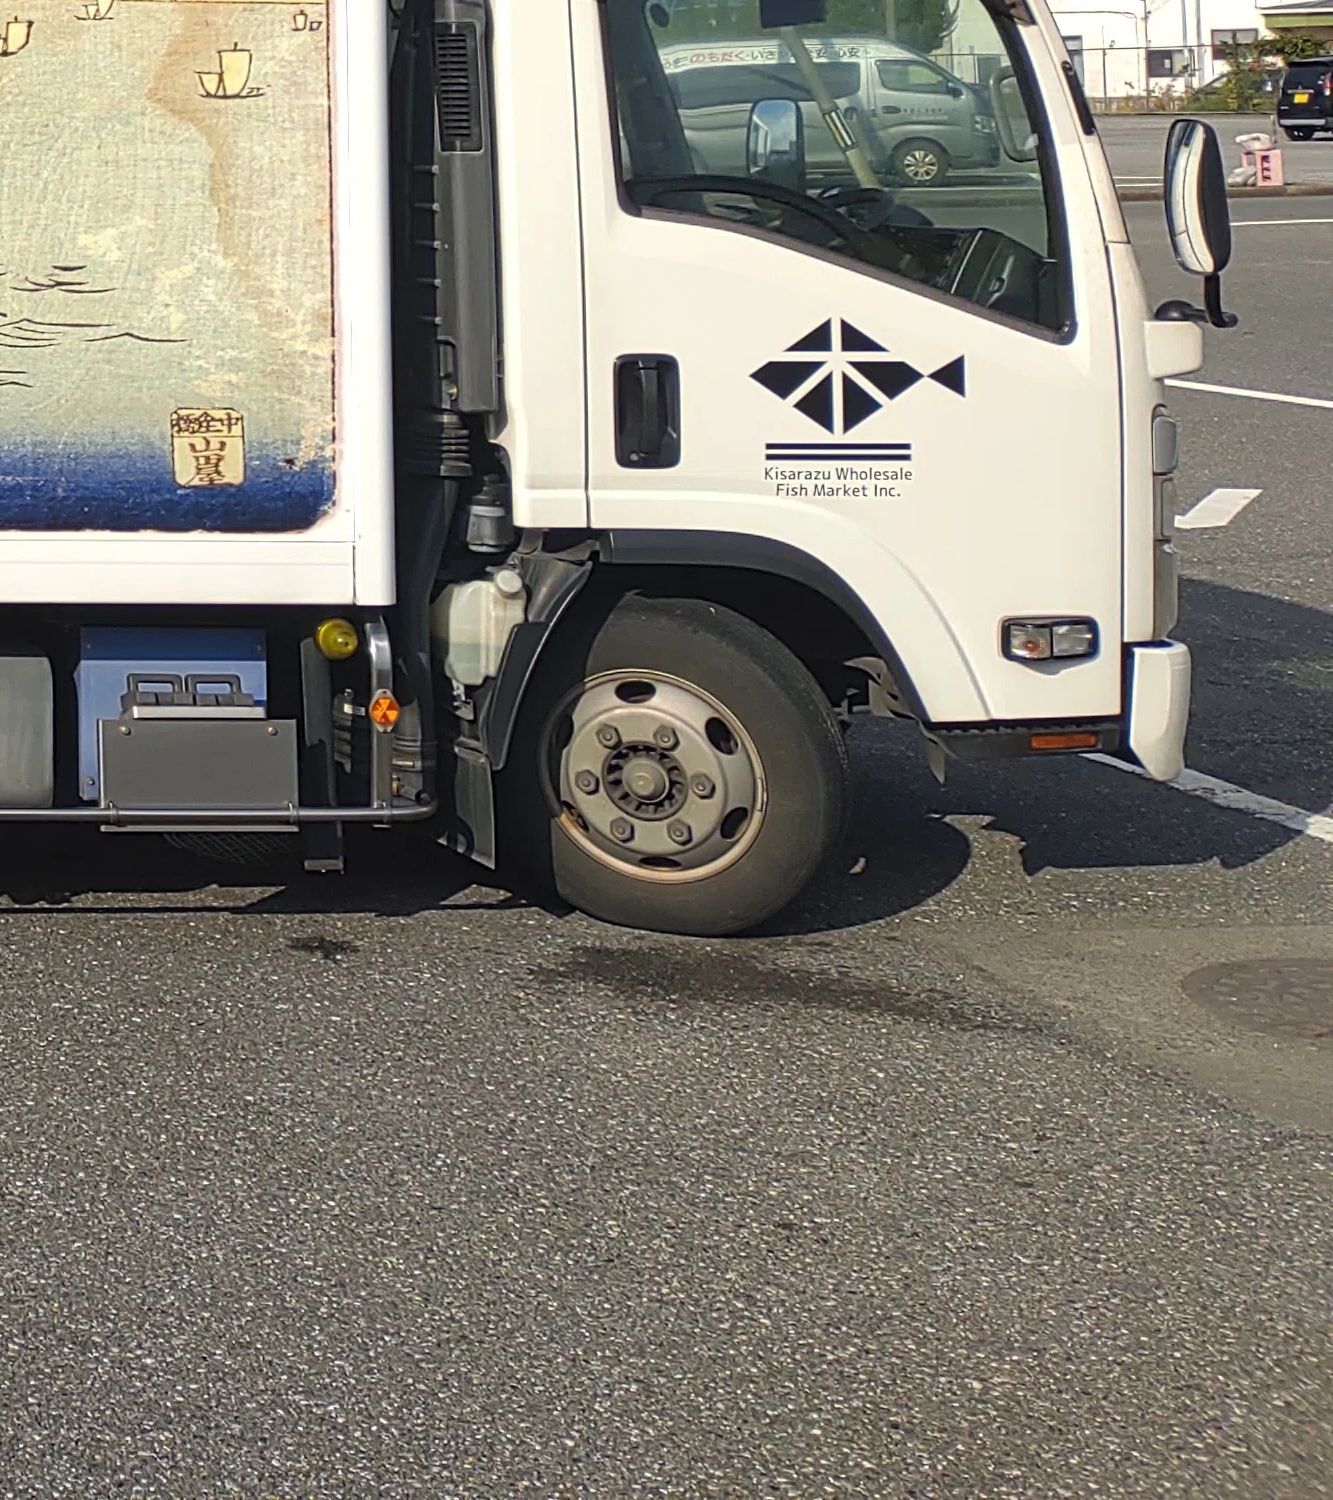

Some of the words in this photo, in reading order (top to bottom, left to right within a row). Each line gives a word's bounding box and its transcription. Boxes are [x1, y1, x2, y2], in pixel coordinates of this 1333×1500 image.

[764, 467, 831, 481] Kisarazu
[835, 467, 913, 481] Wholesale
[776, 484, 808, 497] Fish
[813, 484, 869, 498] Market
[874, 484, 902, 498] Inc.
